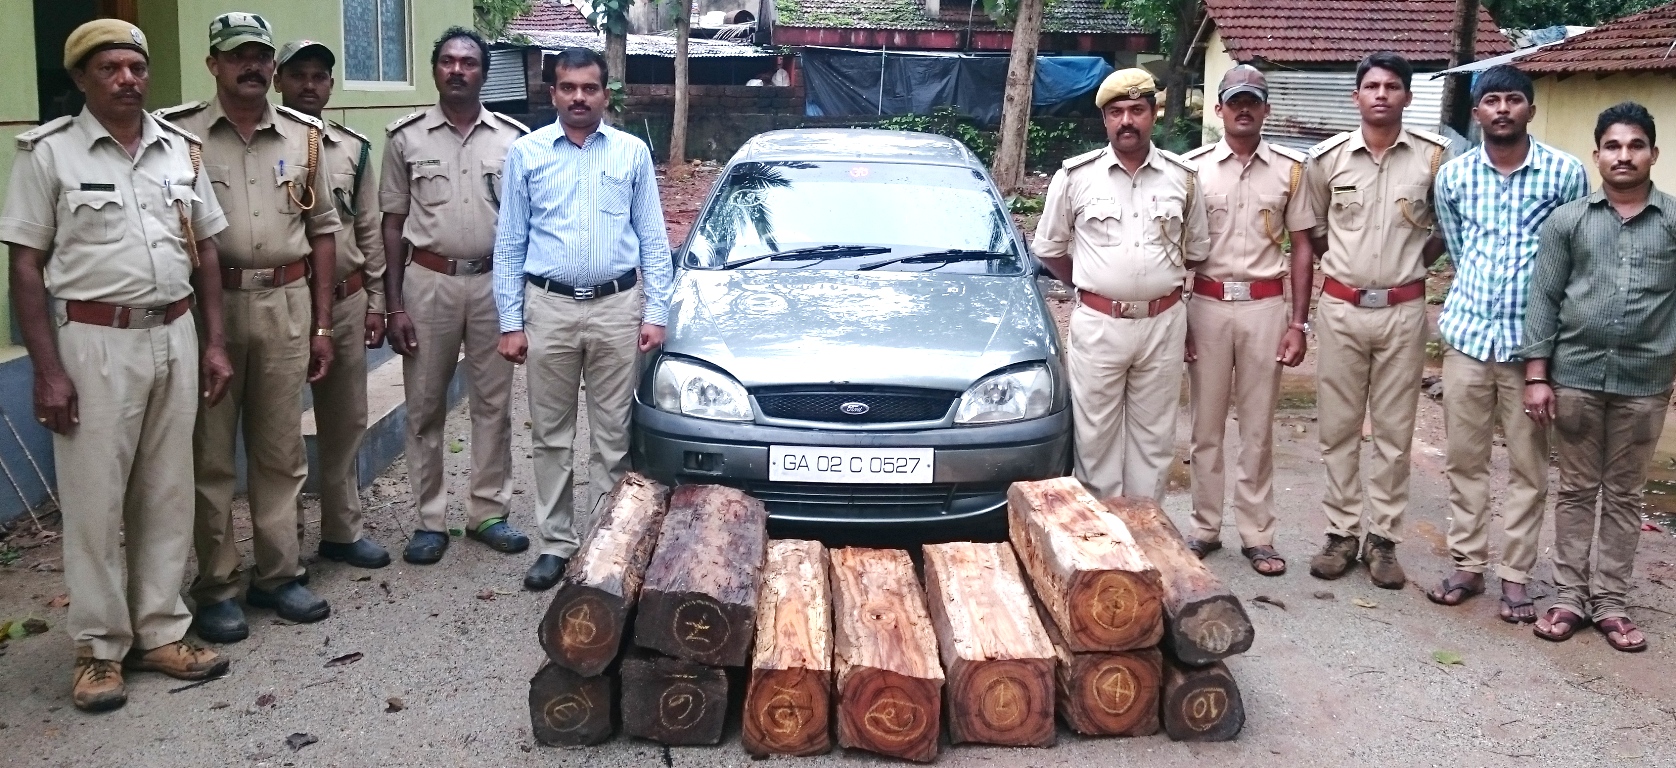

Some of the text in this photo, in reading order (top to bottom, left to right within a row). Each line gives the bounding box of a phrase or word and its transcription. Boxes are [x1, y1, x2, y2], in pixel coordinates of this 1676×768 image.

[783, 454, 921, 474] GA 02 C 0527
